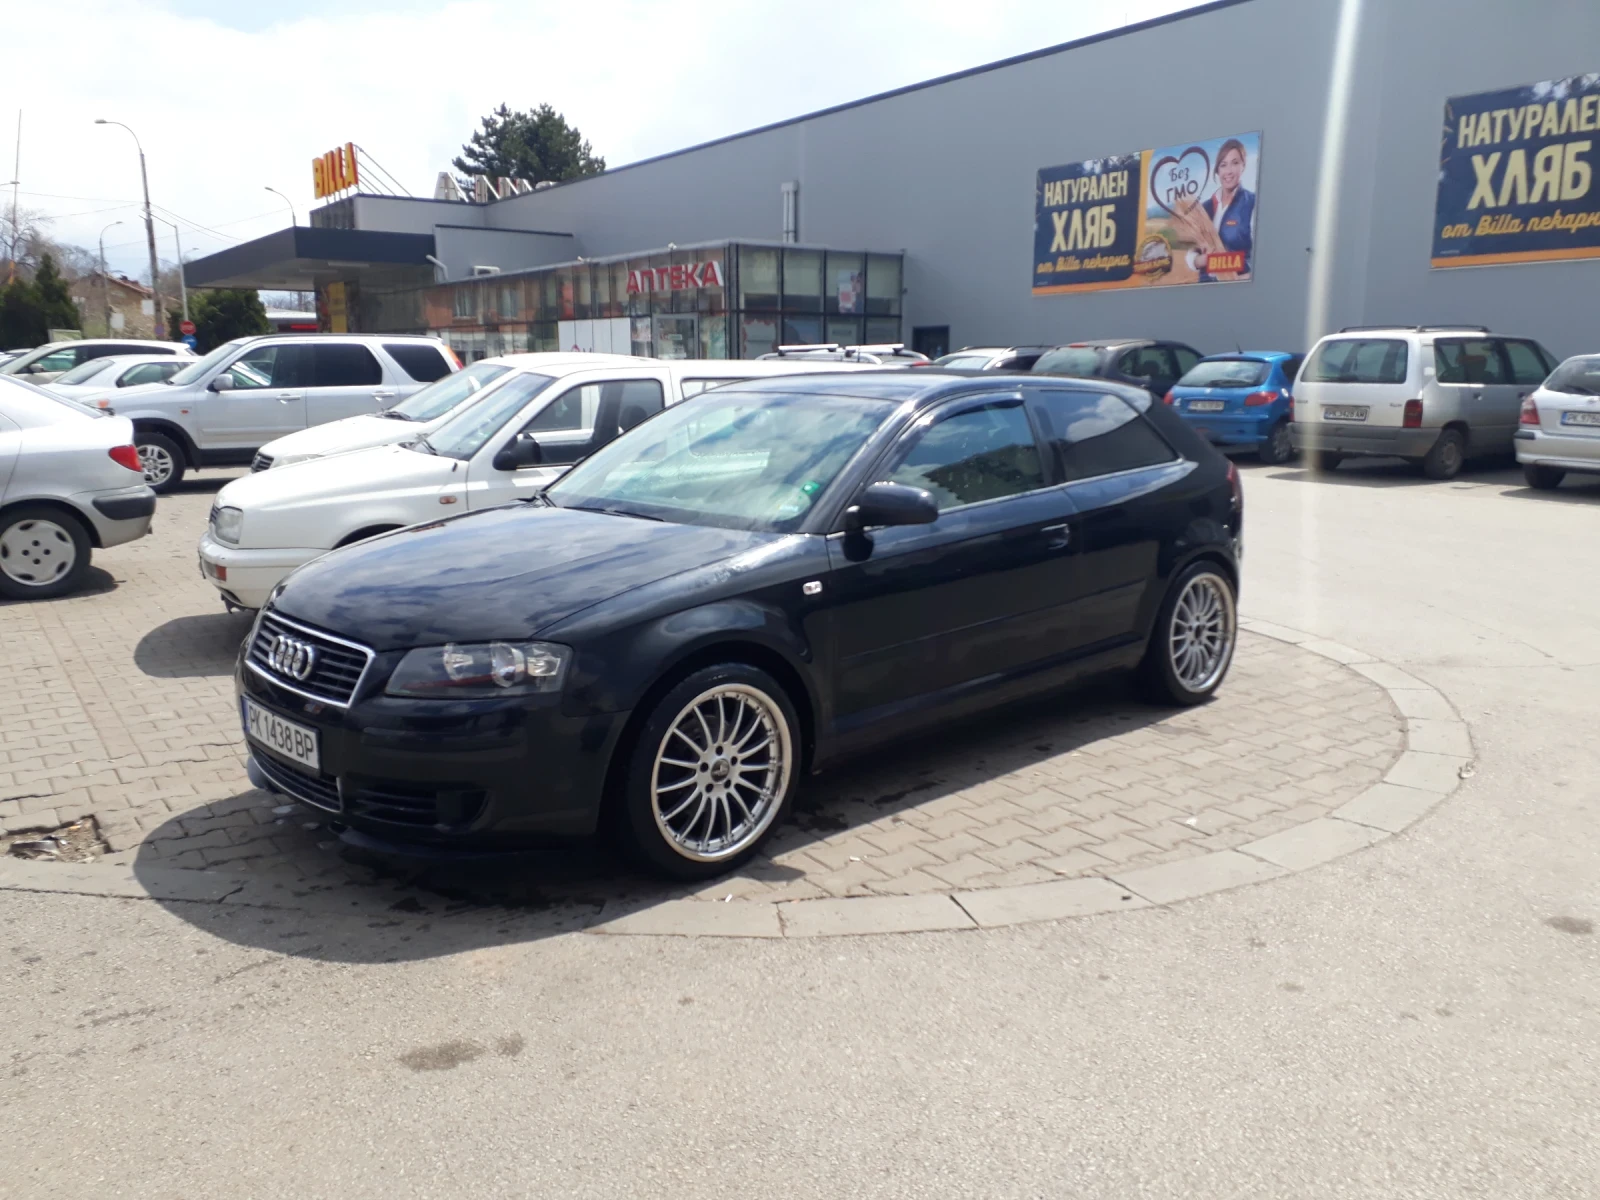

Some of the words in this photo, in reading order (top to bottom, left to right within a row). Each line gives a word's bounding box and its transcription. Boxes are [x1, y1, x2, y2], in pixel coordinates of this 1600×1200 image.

[312, 142, 358, 199] BILLA
[1169, 167, 1189, 182] Без
[1466, 140, 1592, 211] ХЛЯБ
[1044, 170, 1128, 207] НАТУРАЛЕН
[1166, 180, 1199, 203] ГМО
[1051, 204, 1117, 252] ХЛЯБ
[1474, 213, 1525, 237] Billa
[1526, 208, 1600, 234] пекарн
[626, 260, 723, 294] АПТЕКА
[1055, 255, 1080, 272] Billa
[1208, 254, 1242, 270] BILLA
[263, 714, 293, 753] 1438
[294, 729, 314, 761] BP
